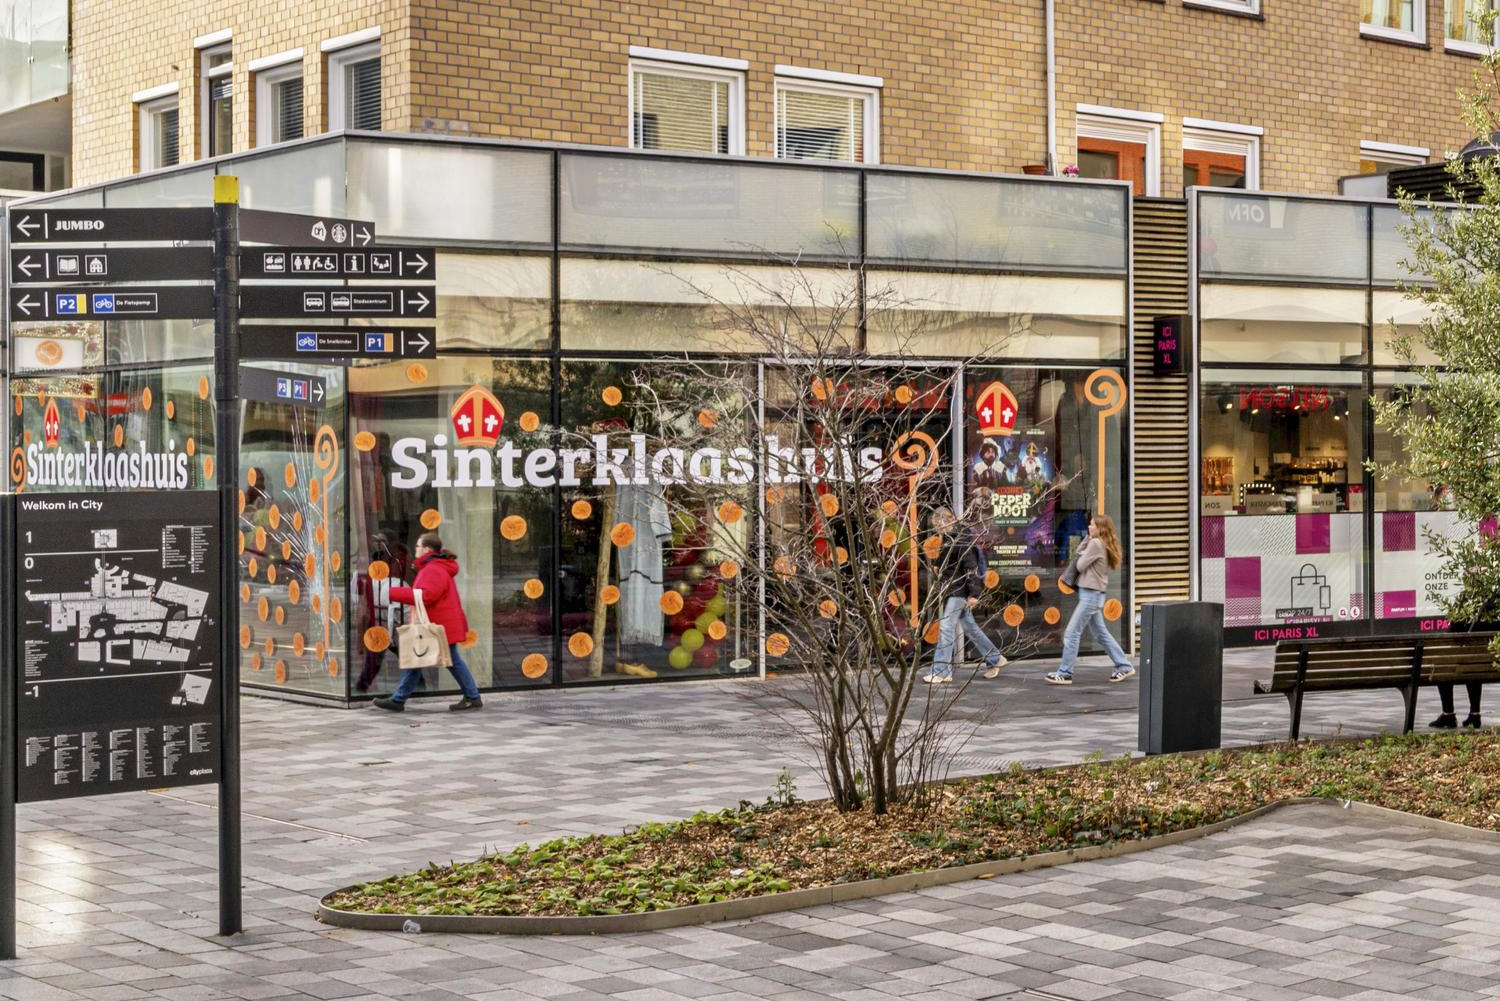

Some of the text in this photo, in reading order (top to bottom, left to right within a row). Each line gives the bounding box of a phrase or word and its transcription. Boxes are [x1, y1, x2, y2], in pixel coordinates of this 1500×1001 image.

[55, 220, 105, 231] JUMBO
[59, 299, 77, 310] P2
[1162, 326, 1172, 337] ICI
[367, 337, 383, 348] P1
[1158, 339, 1177, 350] PARIS
[1163, 353, 1172, 364] XL
[279, 382, 287, 393] P3
[295, 384, 303, 395] P1
[27, 440, 189, 489] Sinterklaashuis
[391, 433, 884, 490] Sinterklaashuis
[991, 493, 1031, 505] PEPER
[22, 499, 103, 512] Welkom in City
[993, 504, 1029, 517] NOOT
[25, 530, 32, 544] 1
[24, 556, 34, 570] 0
[1424, 582, 1449, 591] ONZE
[1420, 620, 1434, 631] ICI
[1254, 625, 1320, 641] ICI PARIS XL
[25, 685, 39, 698] -1
